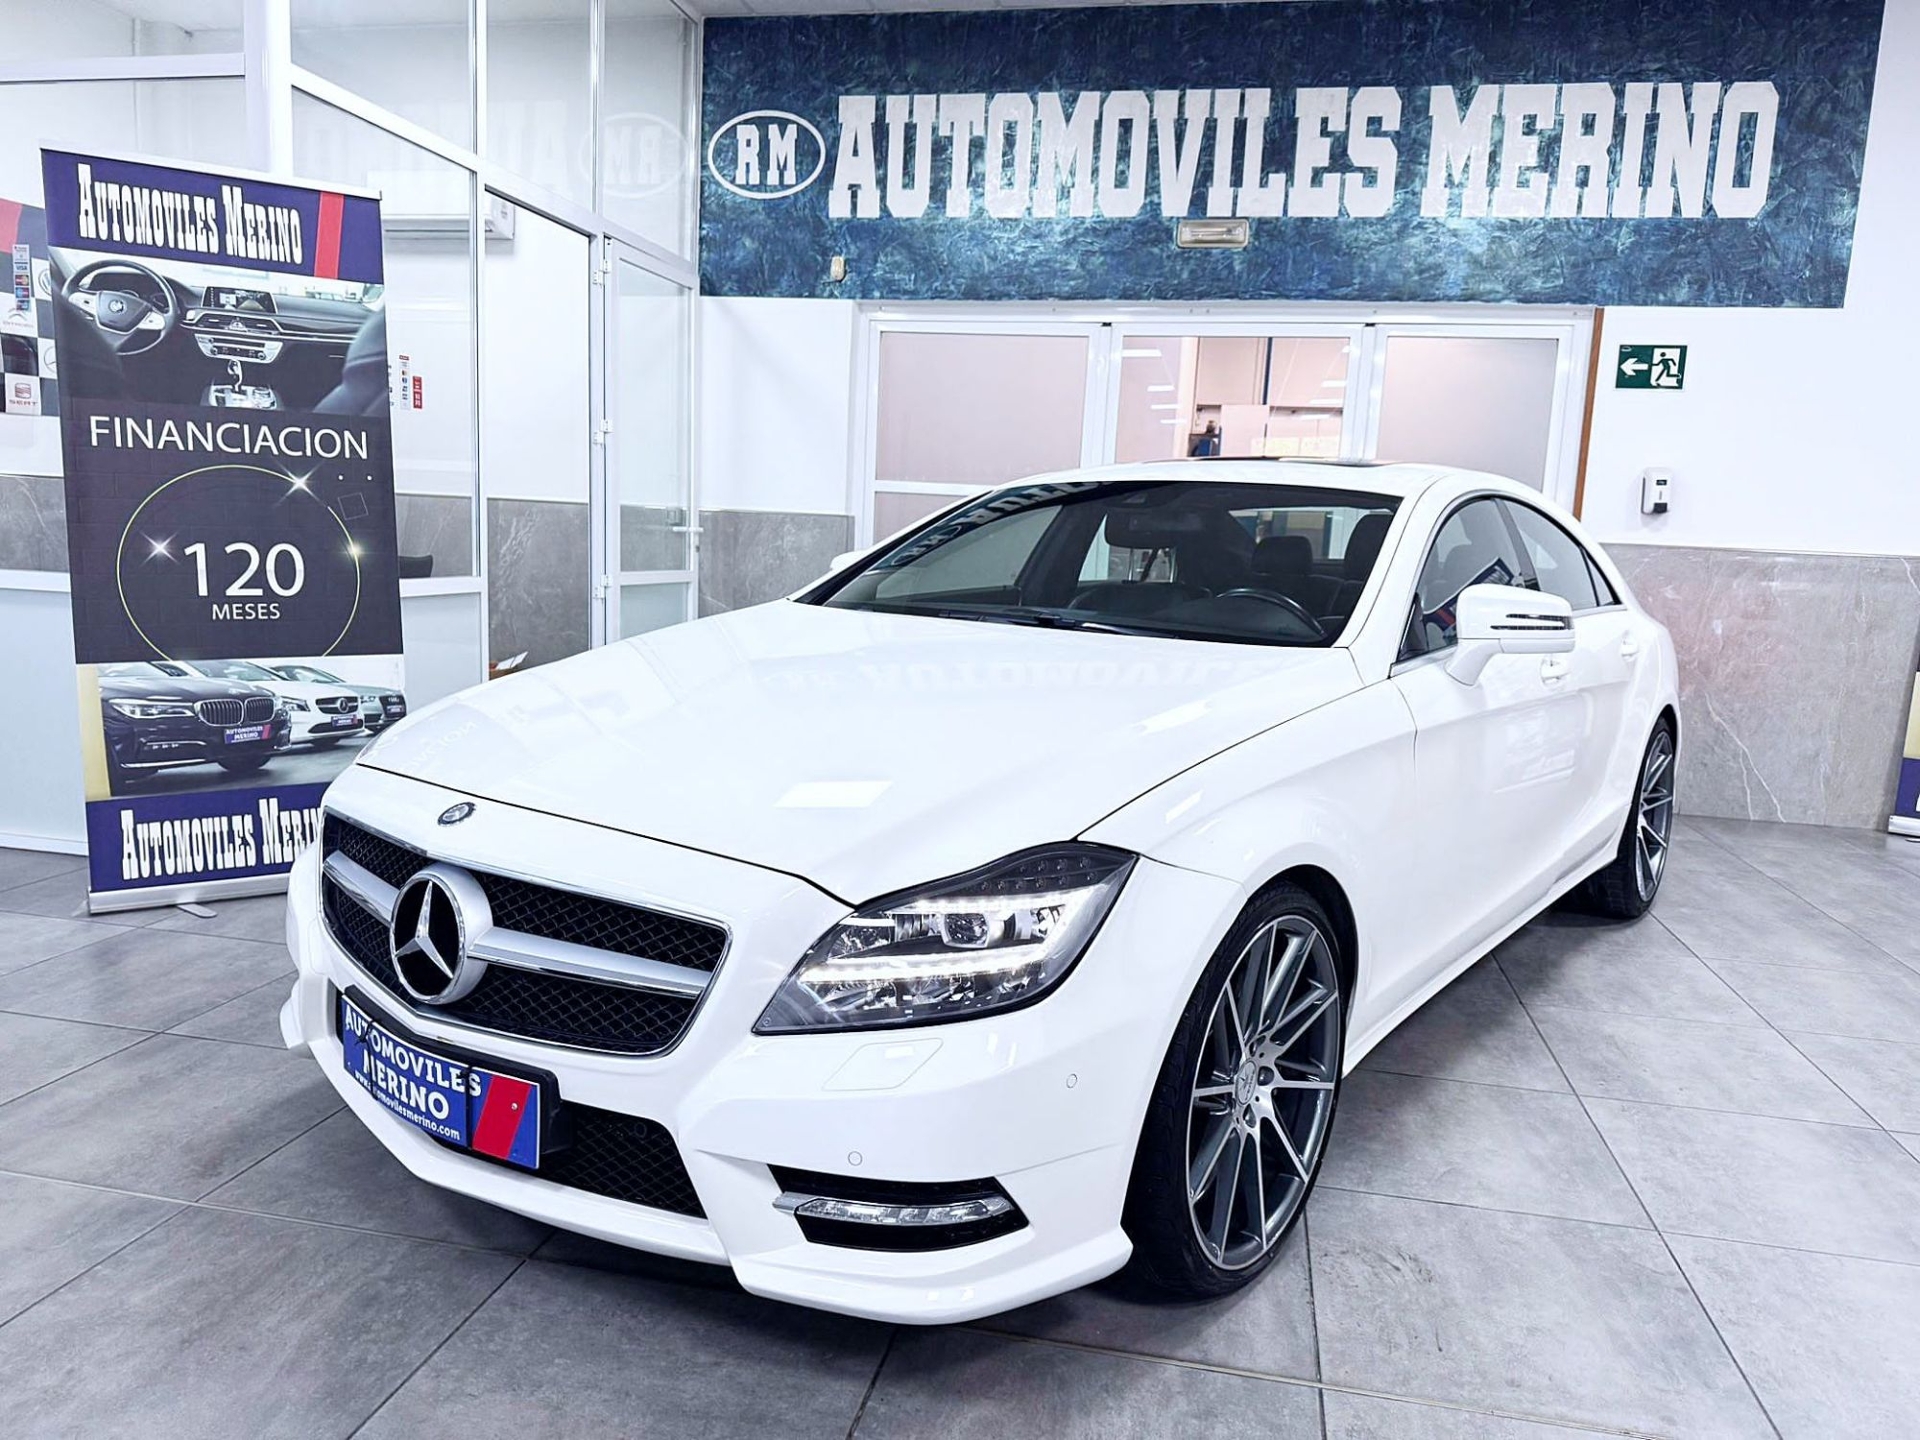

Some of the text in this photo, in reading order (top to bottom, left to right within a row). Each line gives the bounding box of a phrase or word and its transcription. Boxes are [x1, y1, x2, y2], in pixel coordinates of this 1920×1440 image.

[735, 123, 798, 185] RM
[828, 81, 1780, 218] AUTOMOVILES MERINO
[77, 163, 303, 265] AUTOMOVILES MERINO
[90, 416, 369, 459] FINANCIACION
[184, 542, 306, 598] 120
[212, 602, 281, 621] MESES
[121, 797, 322, 881] AUTOMOVILES MERIN
